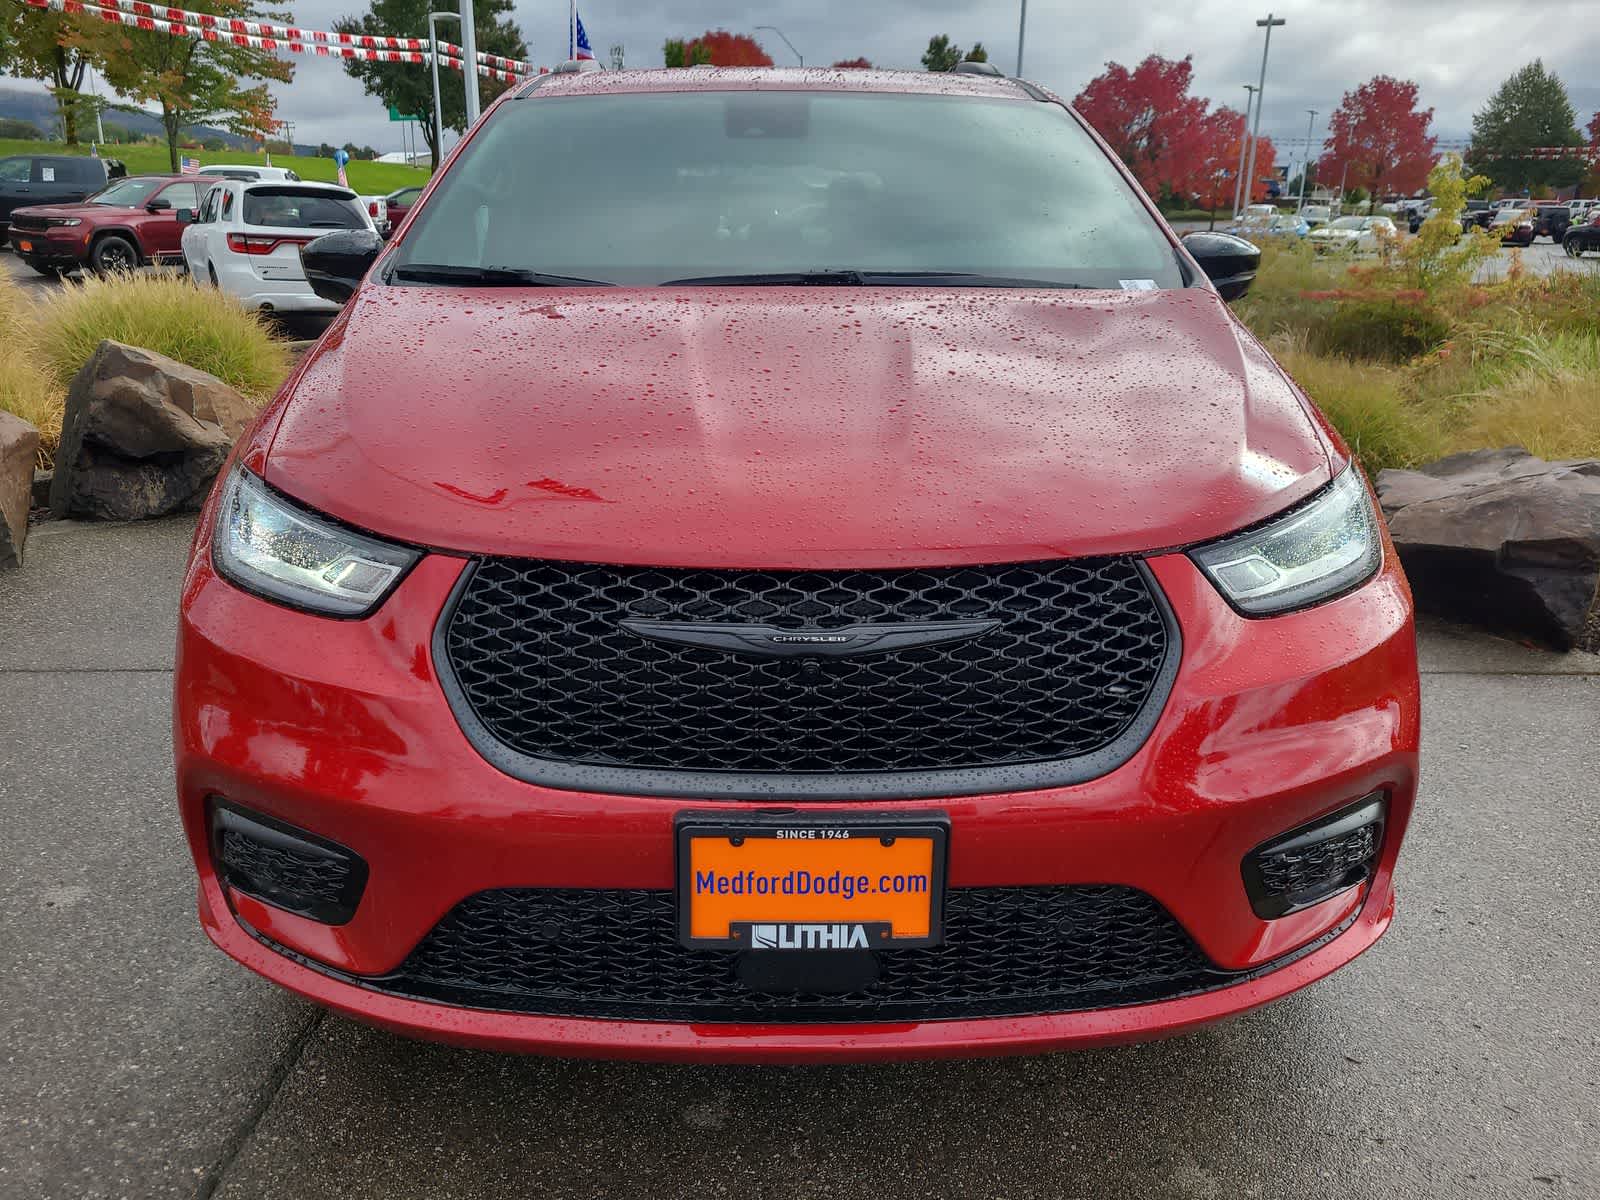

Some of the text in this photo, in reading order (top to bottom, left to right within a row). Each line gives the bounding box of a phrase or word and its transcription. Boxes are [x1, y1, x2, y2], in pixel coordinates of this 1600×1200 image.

[776, 830, 849, 839] SINCE 1946
[696, 870, 927, 900] MedfordDodge.com
[778, 924, 870, 949] LITHIA
